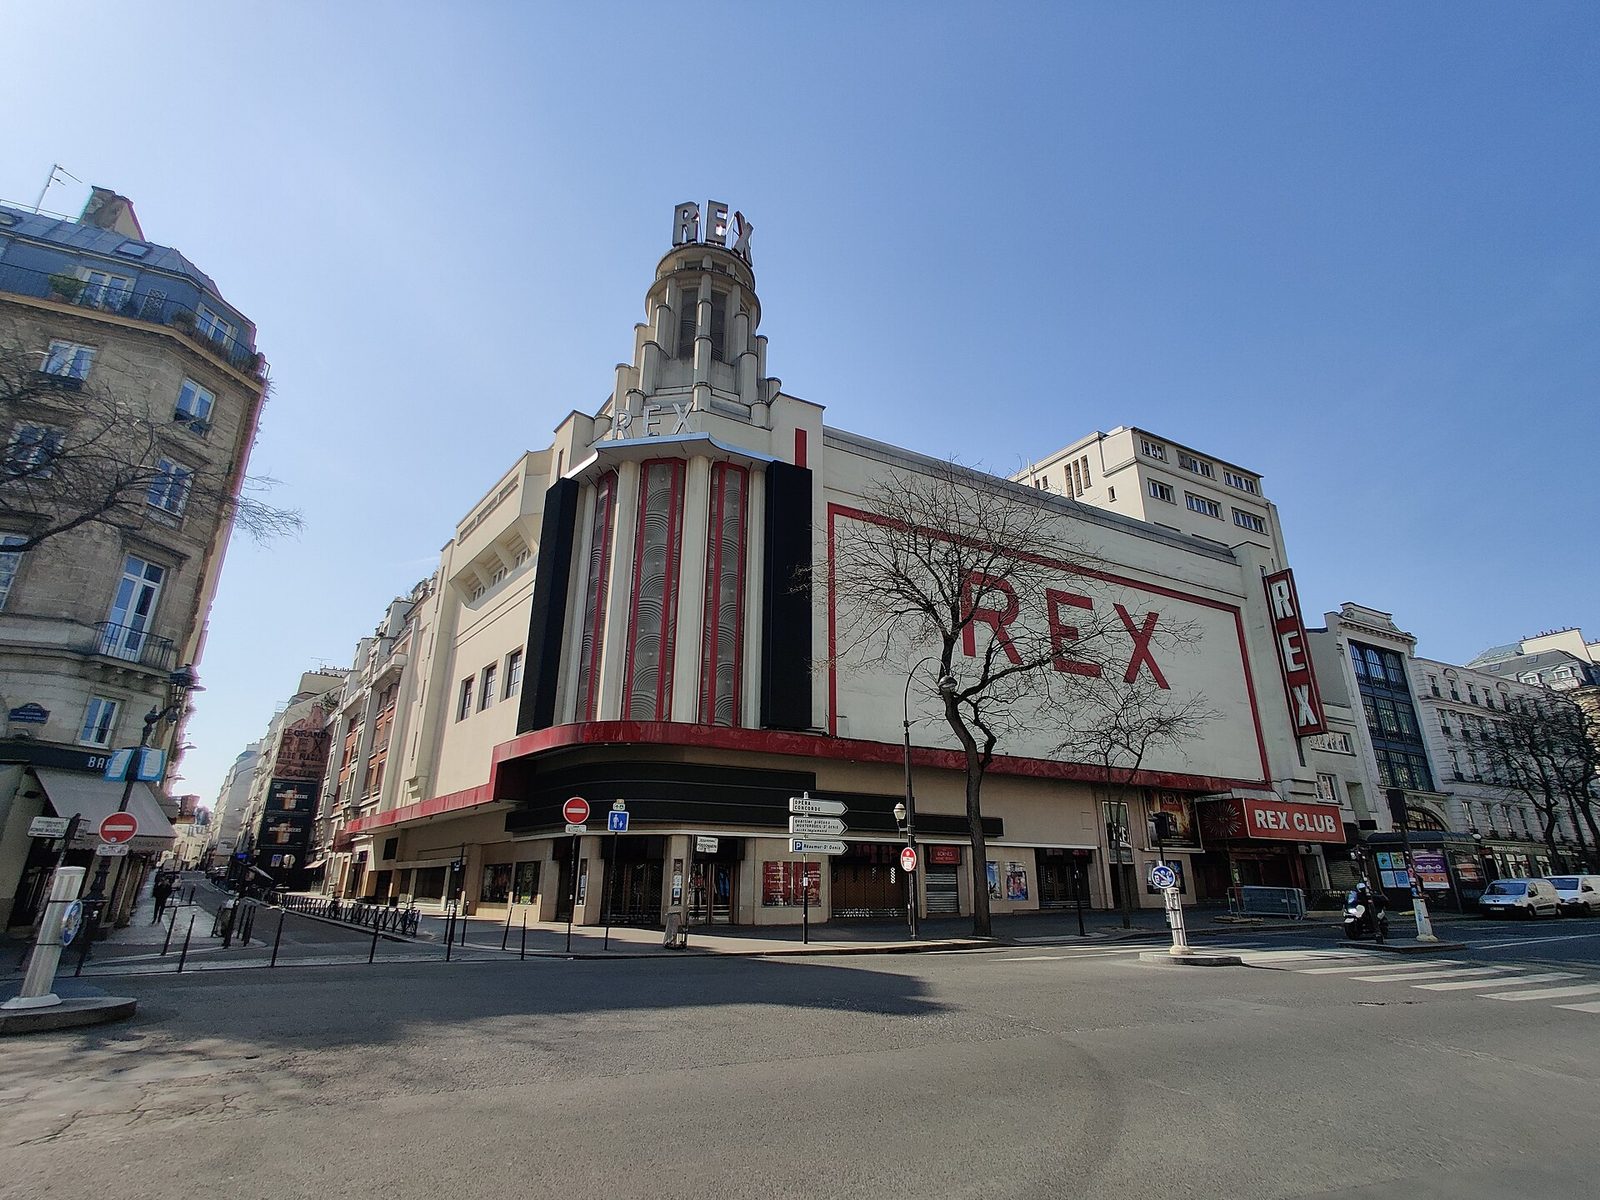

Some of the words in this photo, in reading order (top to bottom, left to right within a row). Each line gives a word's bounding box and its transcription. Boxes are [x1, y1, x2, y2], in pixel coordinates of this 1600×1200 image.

[673, 199, 754, 267] REX
[612, 401, 695, 440] REX
[960, 570, 1171, 690] REX
[1271, 579, 1317, 727] REX
[1254, 809, 1290, 830] REX
[1293, 812, 1337, 833] CLUB
